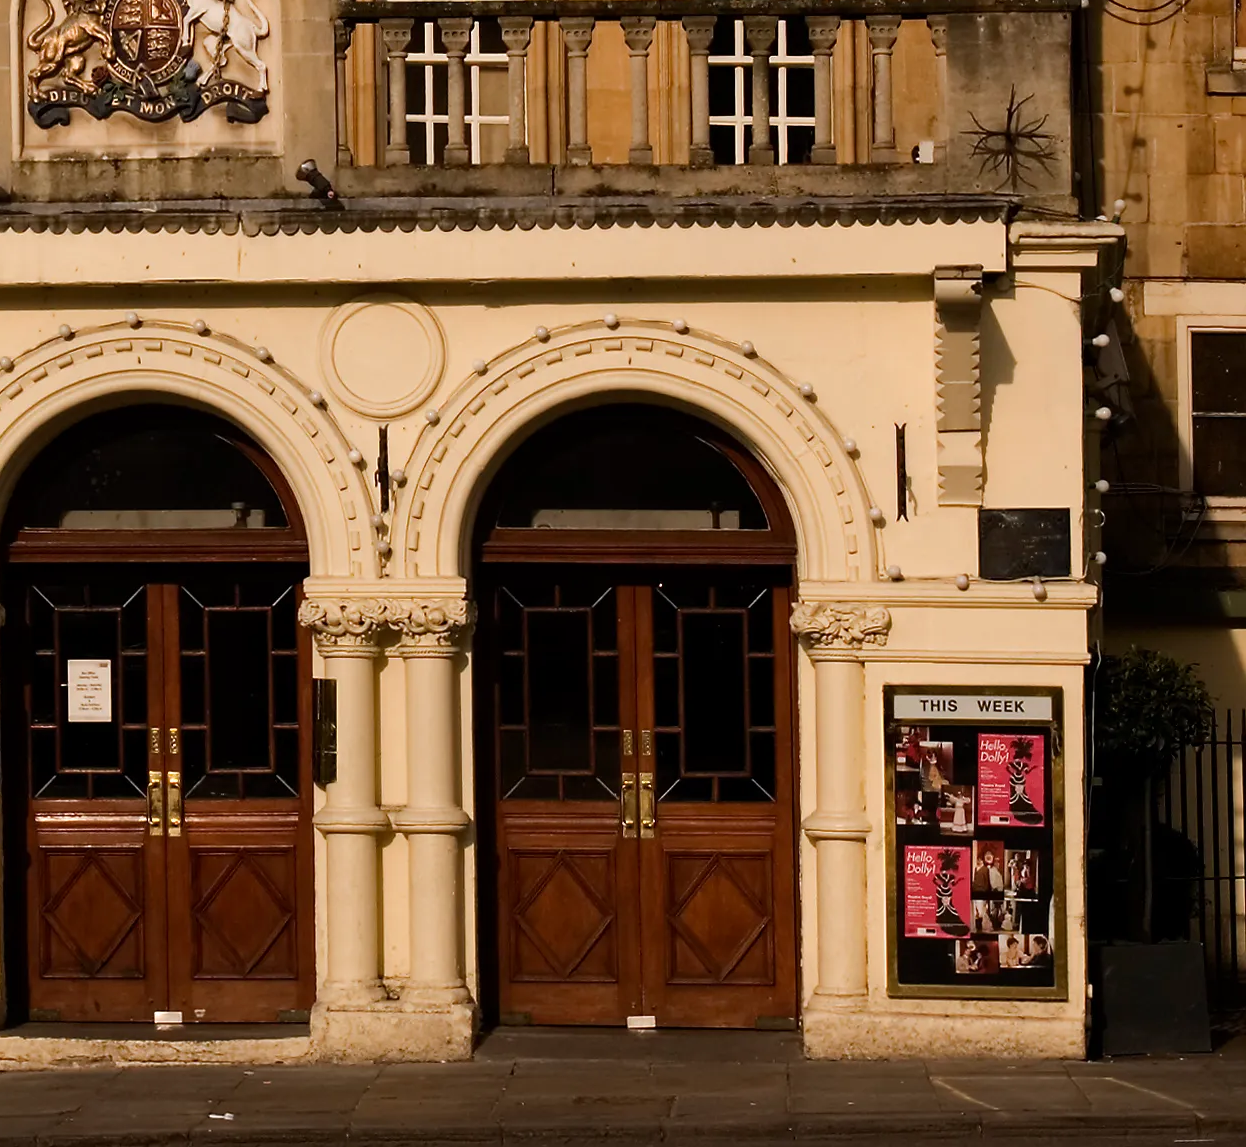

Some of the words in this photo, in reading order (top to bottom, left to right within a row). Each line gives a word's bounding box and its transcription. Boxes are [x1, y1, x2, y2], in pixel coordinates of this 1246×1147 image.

[50, 91, 91, 103] DIEU
[111, 94, 135, 105] ET
[140, 95, 176, 115] MON
[201, 83, 253, 105] DROIT
[920, 699, 958, 712] THIS
[977, 700, 1025, 713] WEEK
[980, 739, 1008, 752] Hello,
[980, 751, 1010, 765] Dolly!
[907, 851, 935, 864] Hello,
[907, 863, 936, 877] Dolly!
